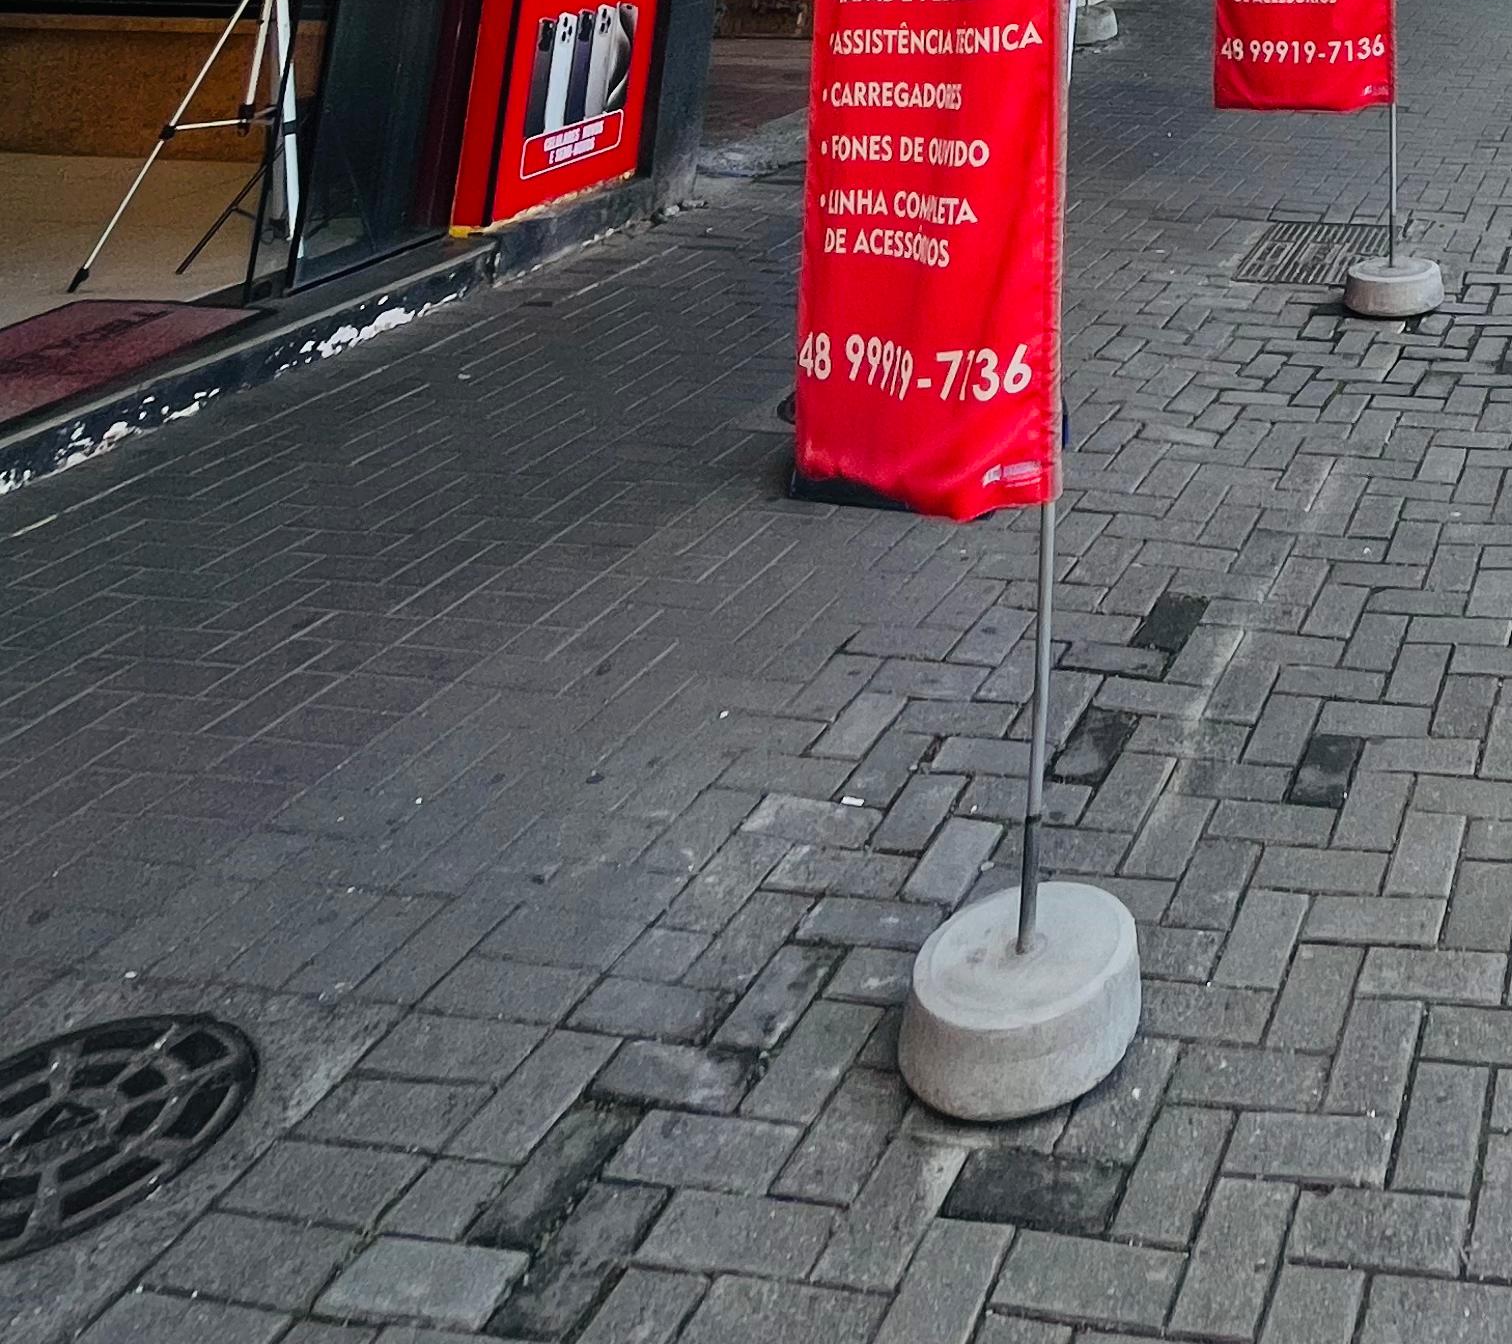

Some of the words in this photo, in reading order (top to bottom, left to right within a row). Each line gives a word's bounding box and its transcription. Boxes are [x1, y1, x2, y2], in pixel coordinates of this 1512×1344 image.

[832, 21, 953, 55] ASSISTÊNCIA
[1220, 37, 1244, 62] 48
[1249, 34, 1386, 64] 99919-7136
[832, 134, 893, 162] FONES
[900, 136, 924, 163] DE
[828, 189, 888, 216] LINHA
[824, 228, 847, 254] DE
[798, 330, 832, 381] 48
[845, 334, 1033, 402] 99919-7136
